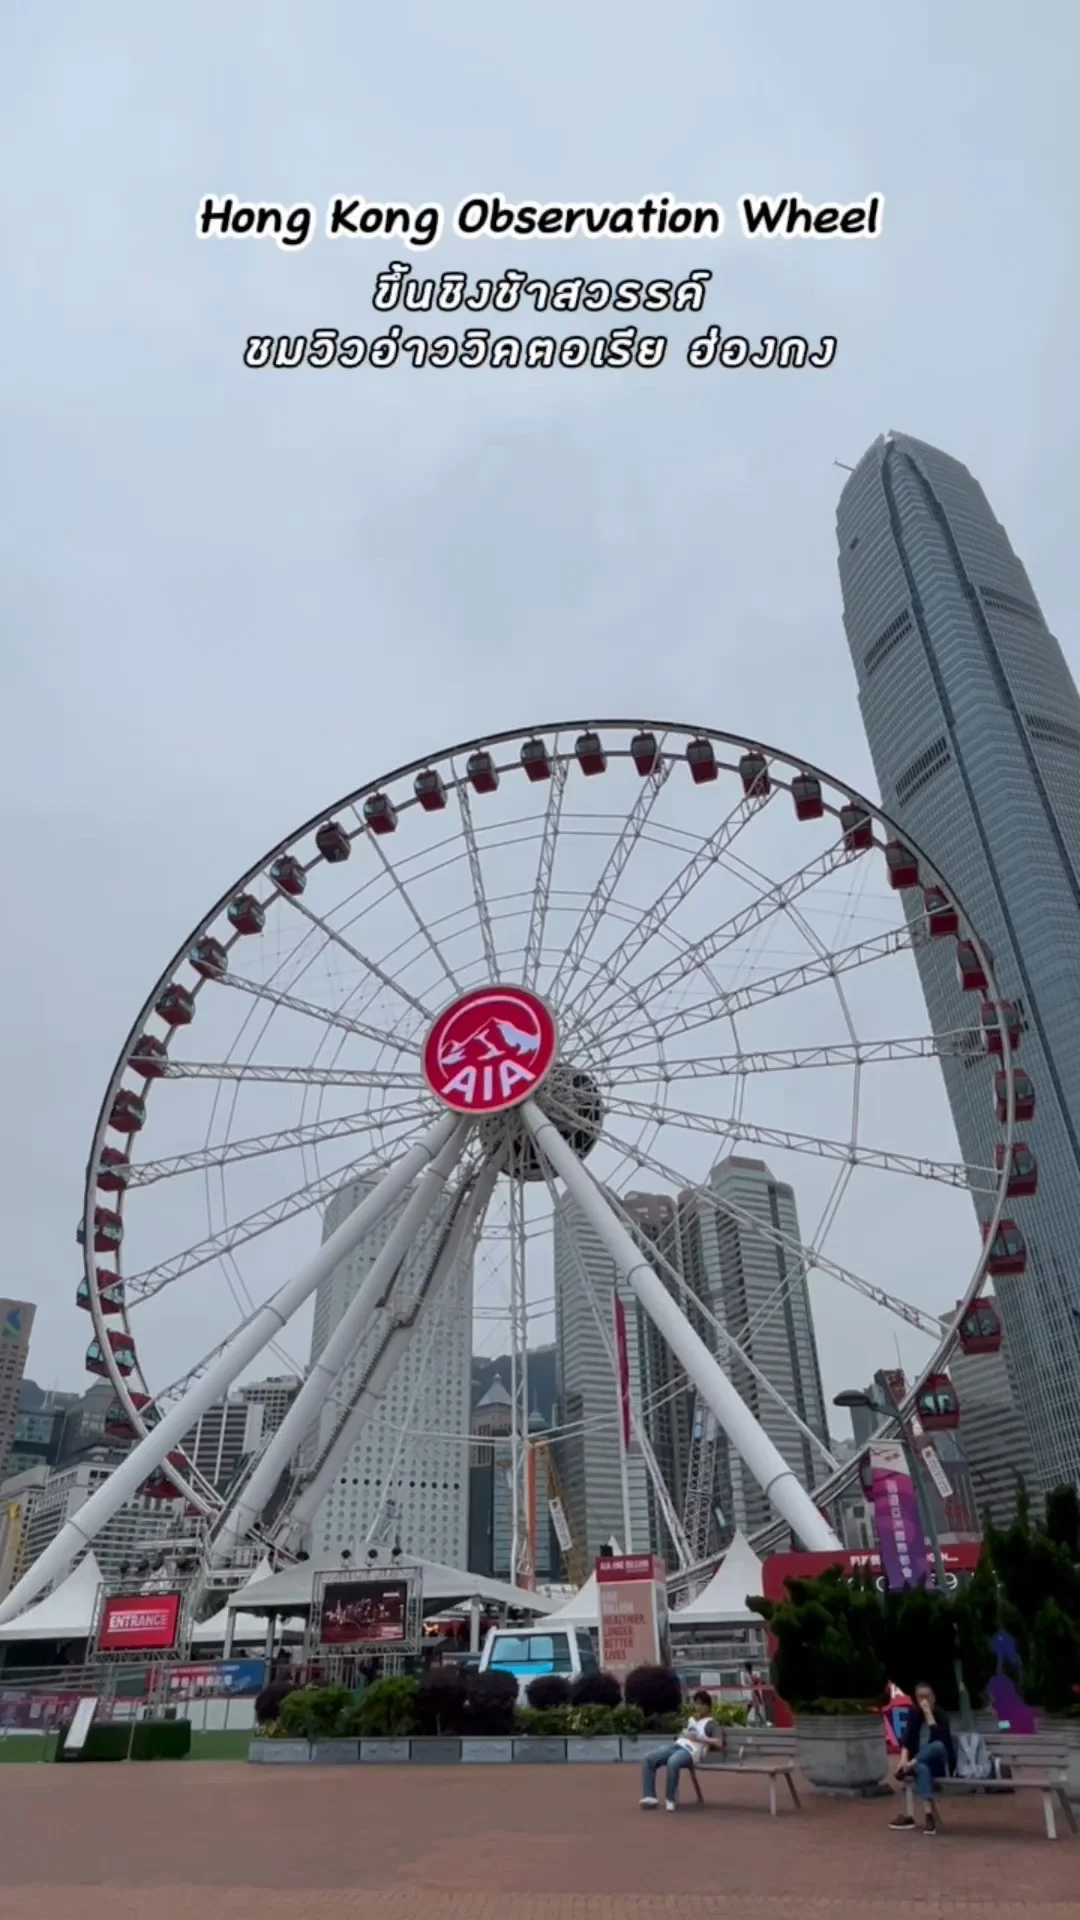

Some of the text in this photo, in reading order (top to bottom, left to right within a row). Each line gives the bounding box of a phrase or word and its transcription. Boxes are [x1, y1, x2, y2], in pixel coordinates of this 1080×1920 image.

[440, 1058, 537, 1104] AIA
[109, 1614, 168, 1629] ENTRANCE
[603, 1637, 634, 1649] BETTER
[604, 1649, 627, 1661] LIVES
